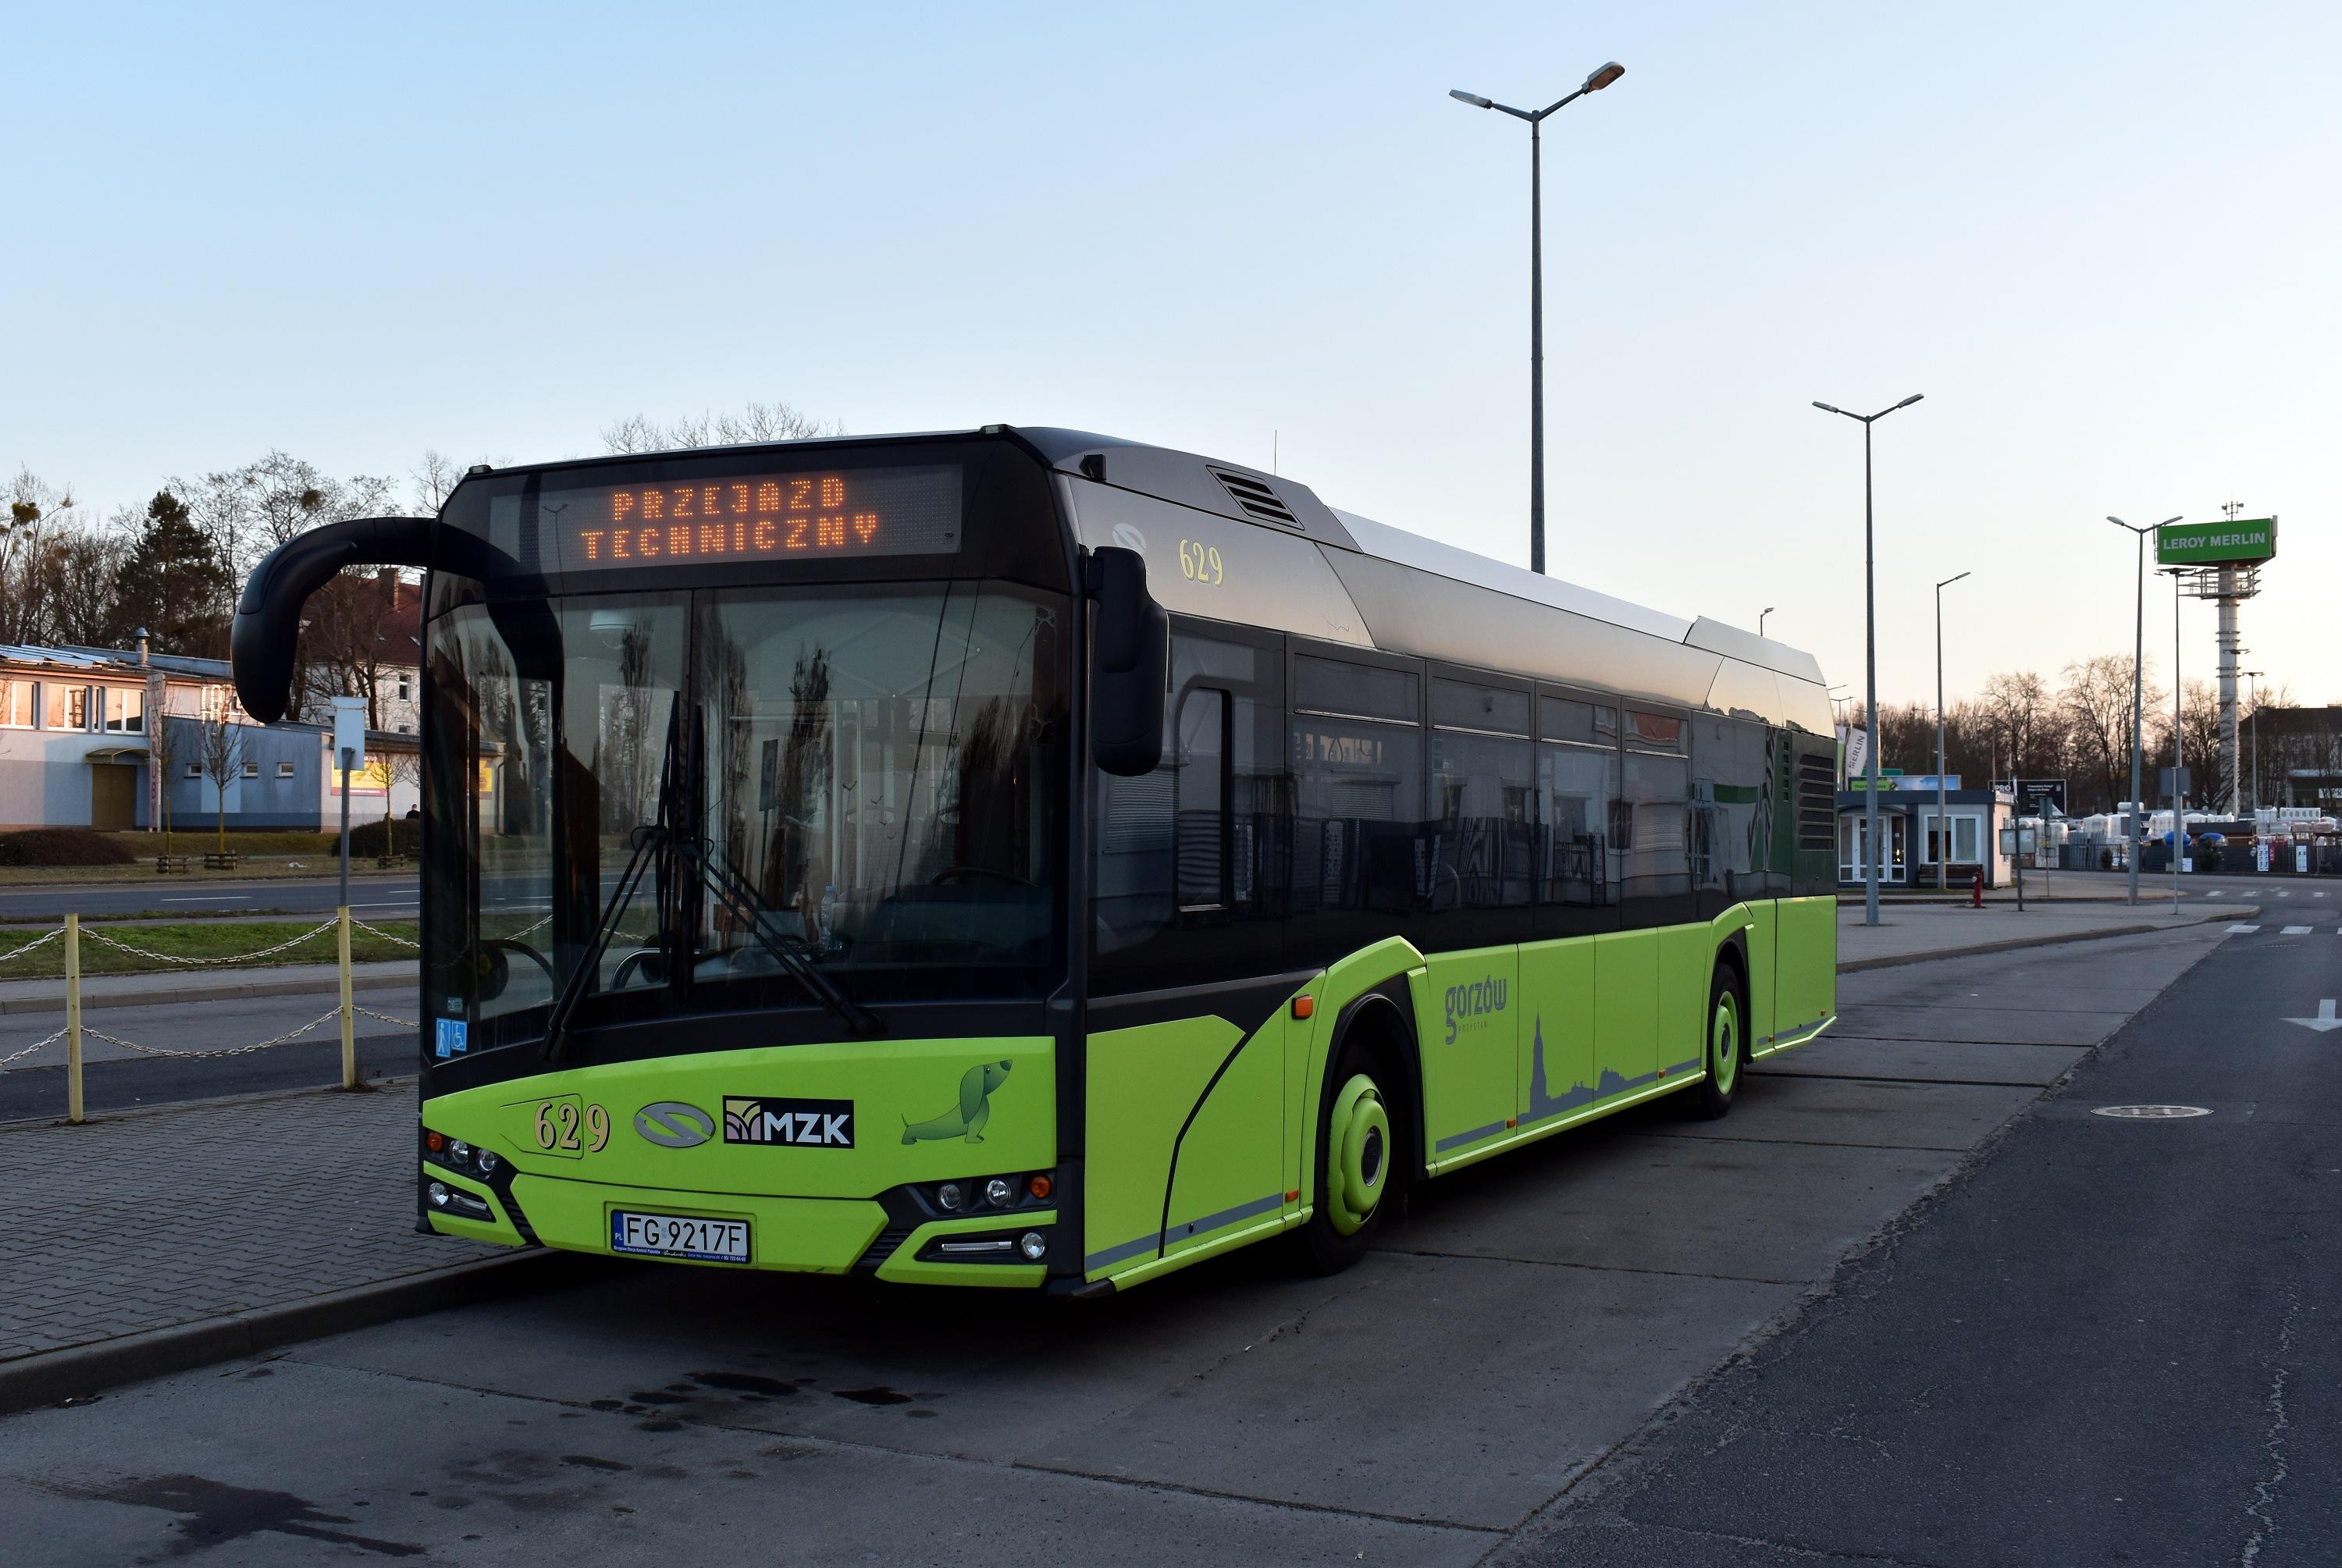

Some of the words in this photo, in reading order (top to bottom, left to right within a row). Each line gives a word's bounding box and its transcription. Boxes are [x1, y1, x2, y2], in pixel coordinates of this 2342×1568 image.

[613, 478, 845, 521] PRZEJAZD
[580, 514, 879, 560] TECHNICZNY
[2163, 536, 2206, 550] LEROY
[2210, 532, 2265, 546] MERLIN
[1179, 538, 1224, 586] 629
[1445, 974, 1507, 1045] gorzów
[533, 1102, 611, 1153] 629
[763, 1112, 851, 1145] MZK
[615, 1232, 623, 1241] PL
[627, 1217, 660, 1246] FG
[668, 1221, 742, 1253] 9217F
